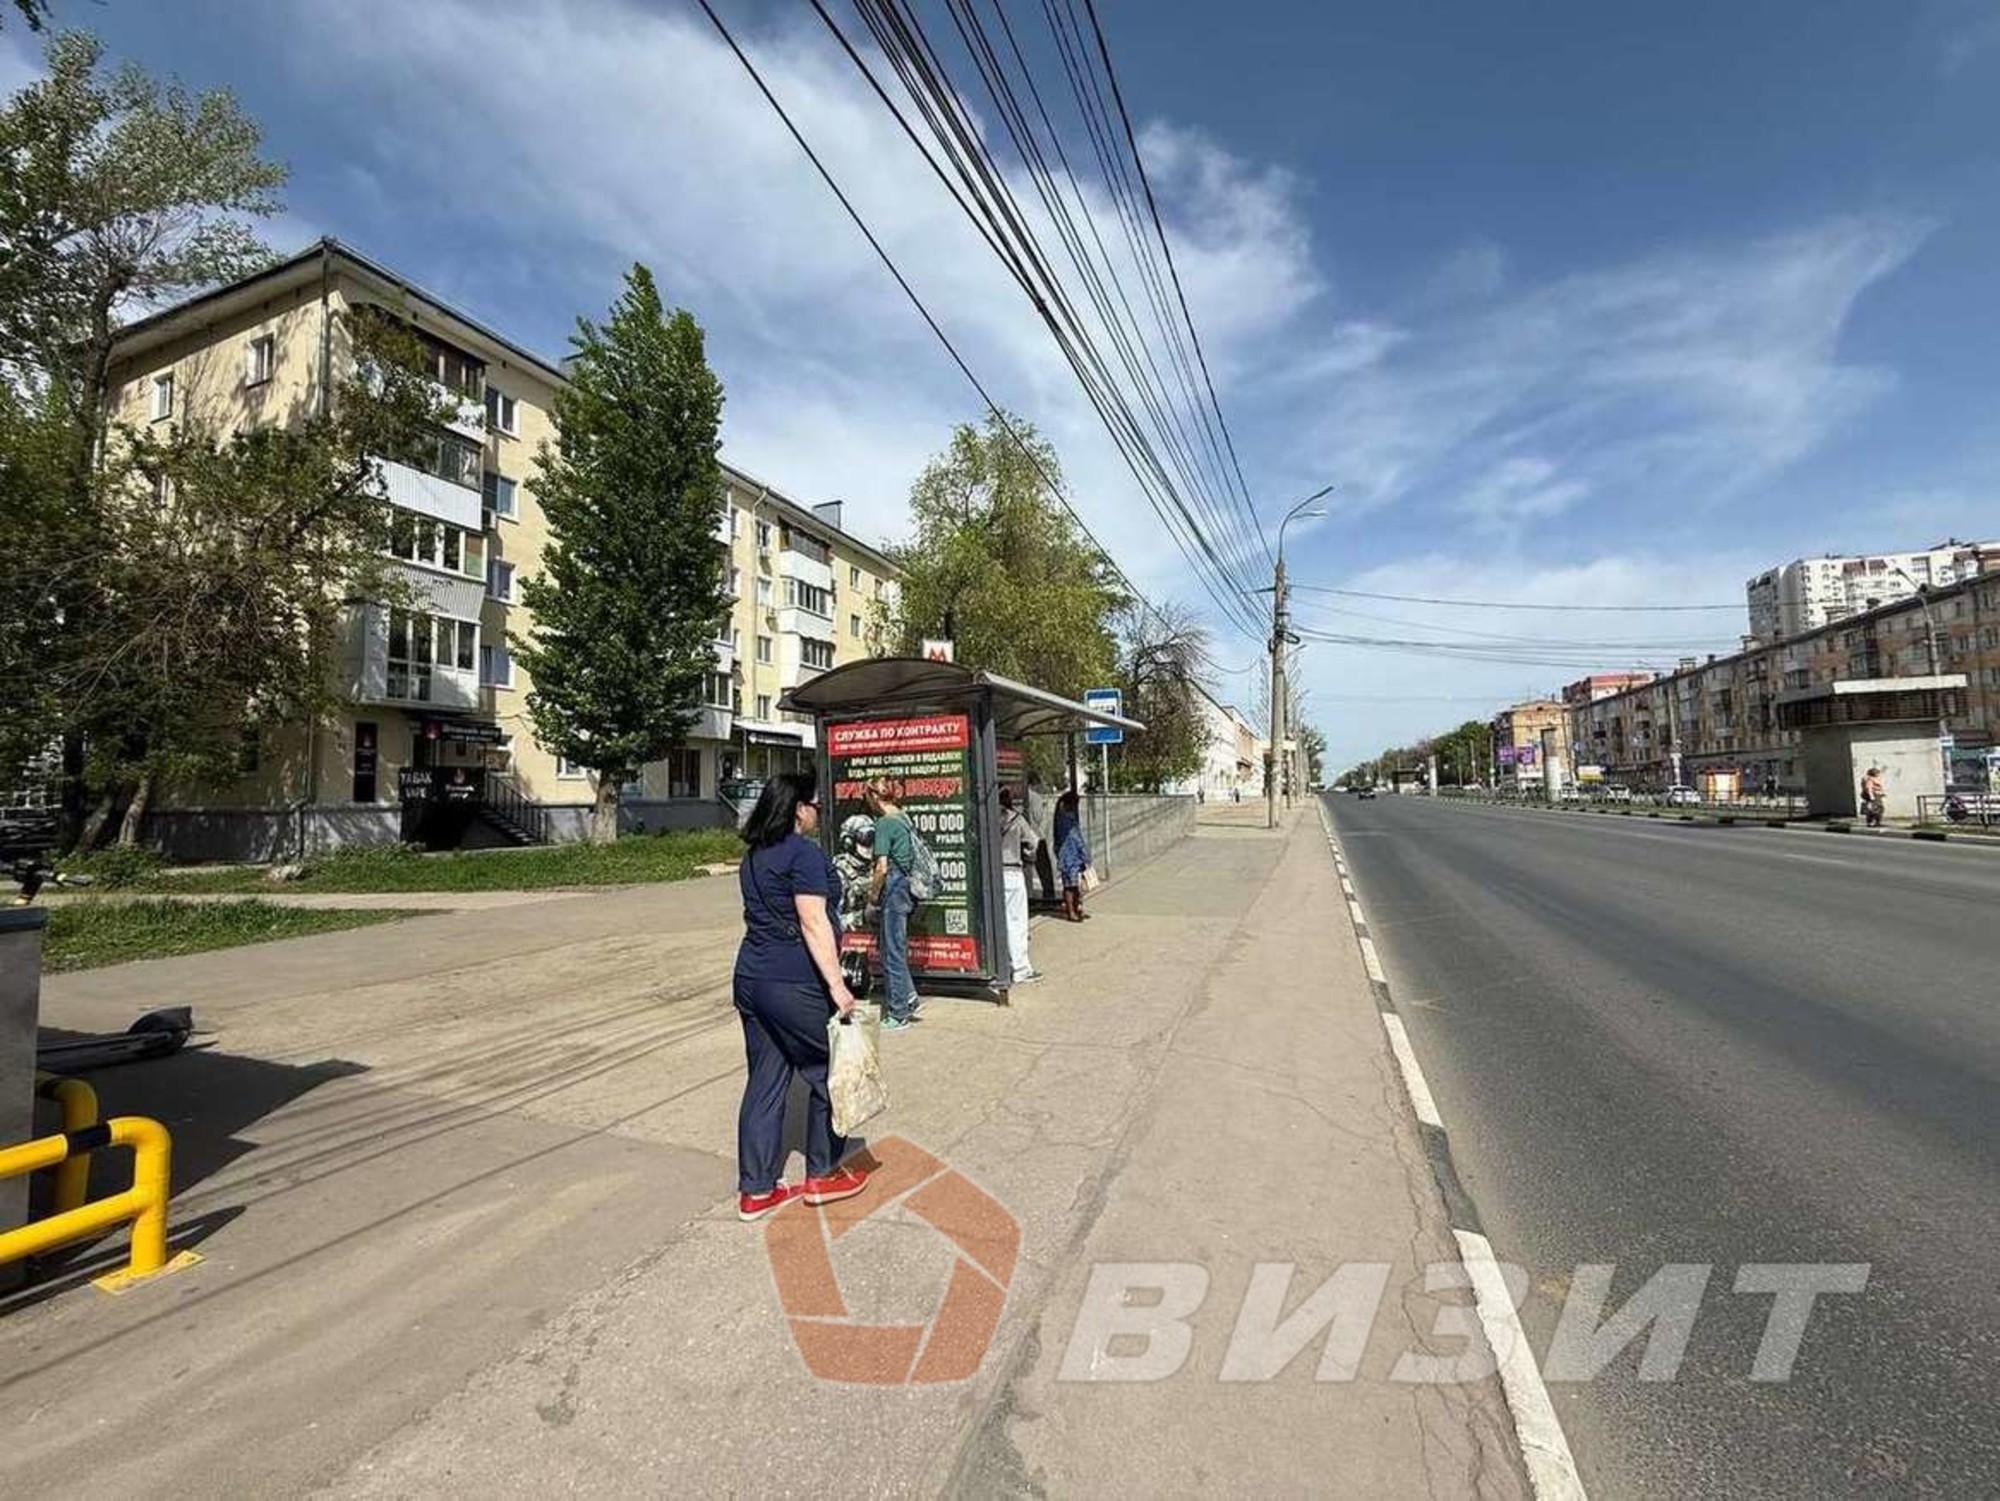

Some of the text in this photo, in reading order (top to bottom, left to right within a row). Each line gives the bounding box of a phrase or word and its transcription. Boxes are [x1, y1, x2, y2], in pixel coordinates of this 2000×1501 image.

[835, 721, 960, 742] СЛУЖБА ПО КОНТРАКТУ
[912, 813, 965, 832] 100 000
[941, 861, 967, 879] 000
